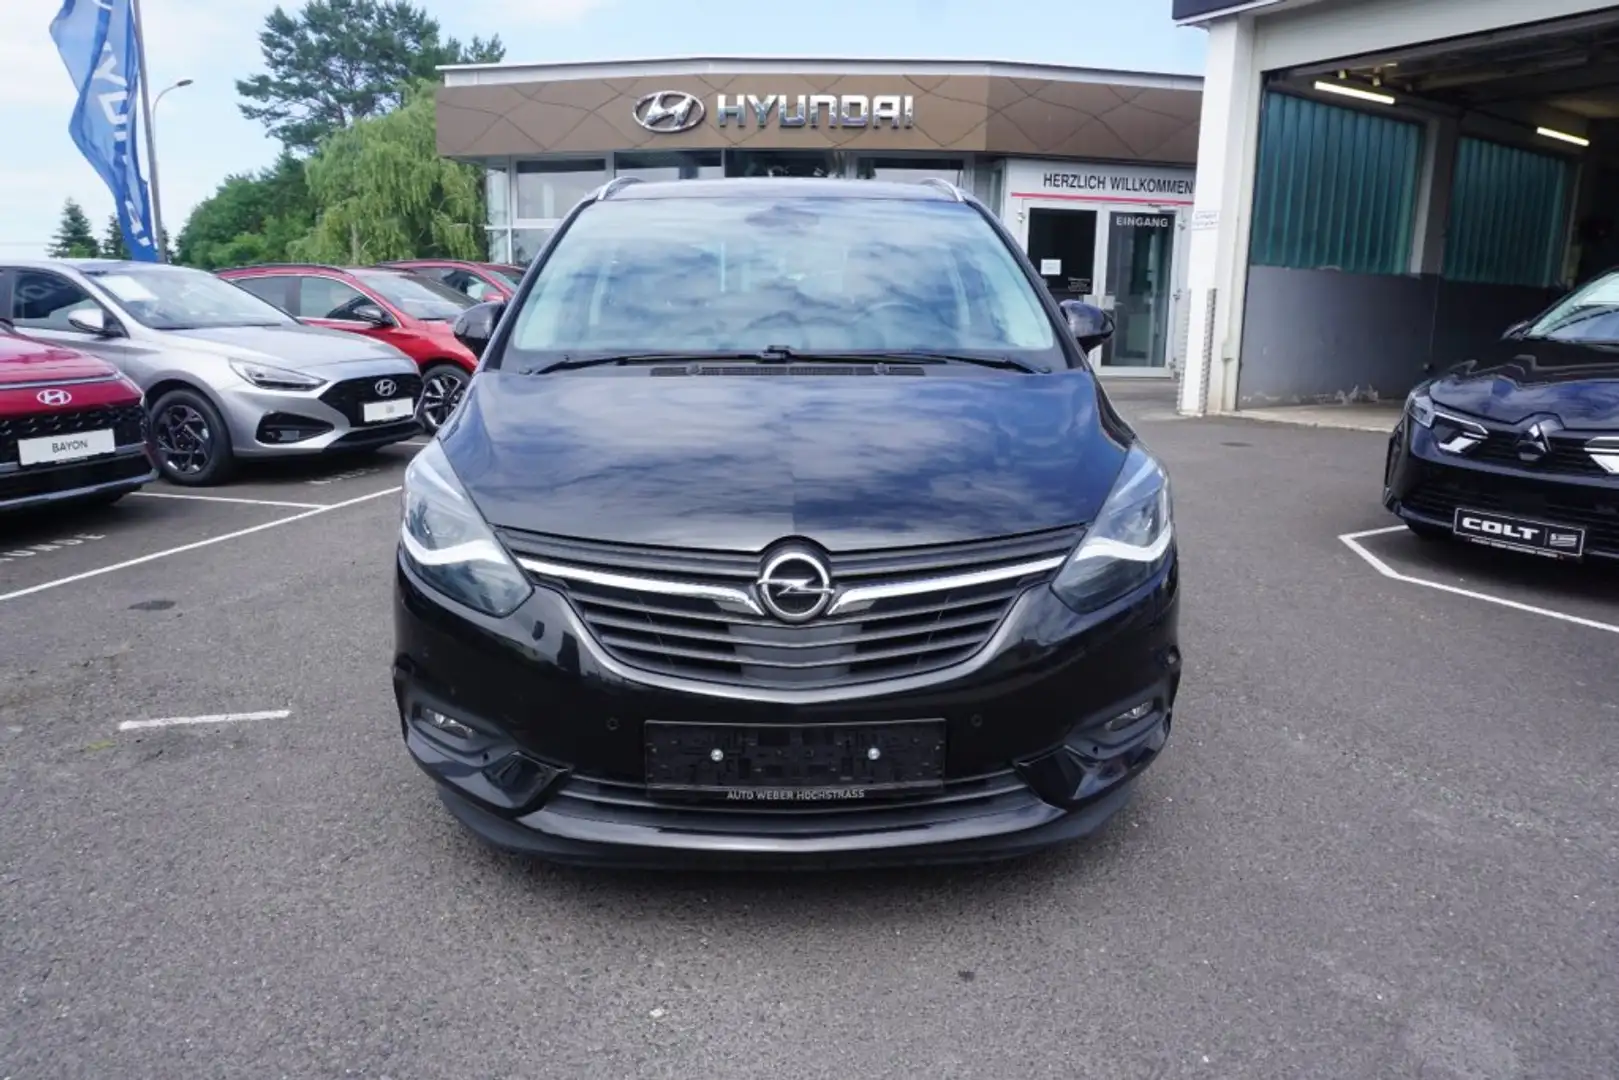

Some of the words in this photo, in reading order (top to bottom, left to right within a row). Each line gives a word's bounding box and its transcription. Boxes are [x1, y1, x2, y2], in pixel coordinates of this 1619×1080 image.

[716, 94, 915, 129] HYUNDAI
[1043, 173, 1107, 190] HERZLICH
[1109, 176, 1194, 194] WILLKOMMEN
[1115, 216, 1169, 228] EINGANG
[51, 440, 88, 454] BAYON
[1462, 517, 1540, 540] COLT
[727, 790, 754, 800] AUTO
[757, 790, 794, 800] WEBER
[797, 789, 865, 800] HOCHSTRASS
